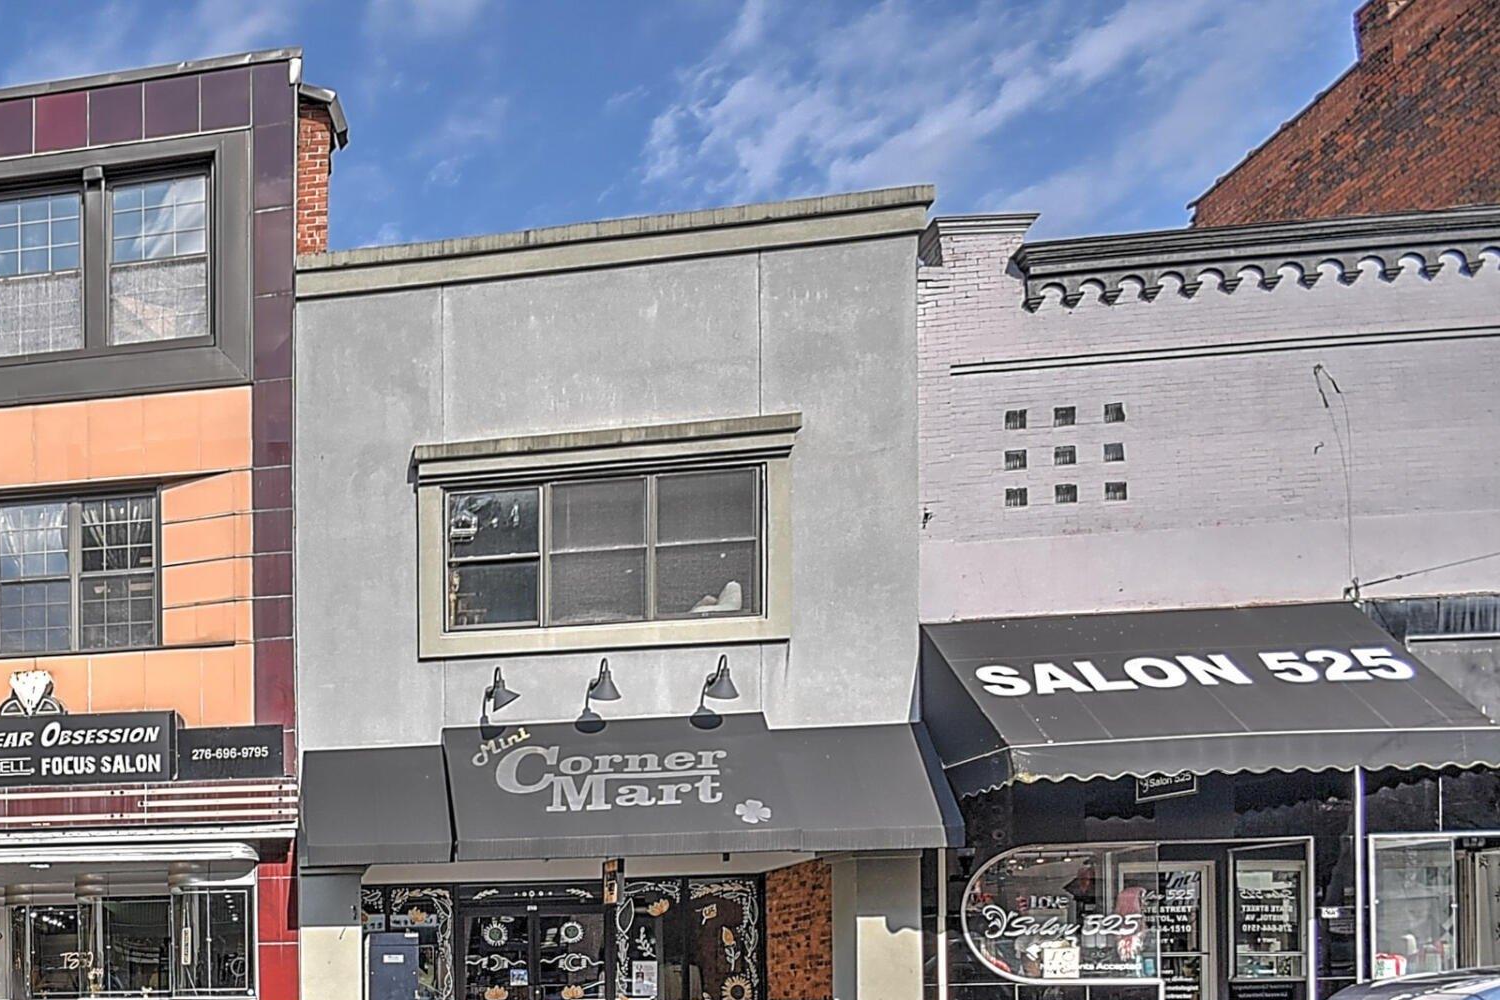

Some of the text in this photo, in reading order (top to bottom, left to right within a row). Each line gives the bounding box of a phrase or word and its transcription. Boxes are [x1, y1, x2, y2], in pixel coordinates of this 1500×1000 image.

[975, 648, 1415, 697] SALON 525
[191, 746, 269, 760] 276-696-9795
[471, 726, 532, 767] Mini
[41, 754, 161, 776] FOCUS SALON
[495, 745, 728, 795] Corner
[545, 774, 724, 813] Mart
[1149, 776, 1173, 788] Salon
[1165, 889, 1195, 900] 525
[1004, 913, 1142, 937] Salon 525
[1176, 914, 1188, 922] VA
